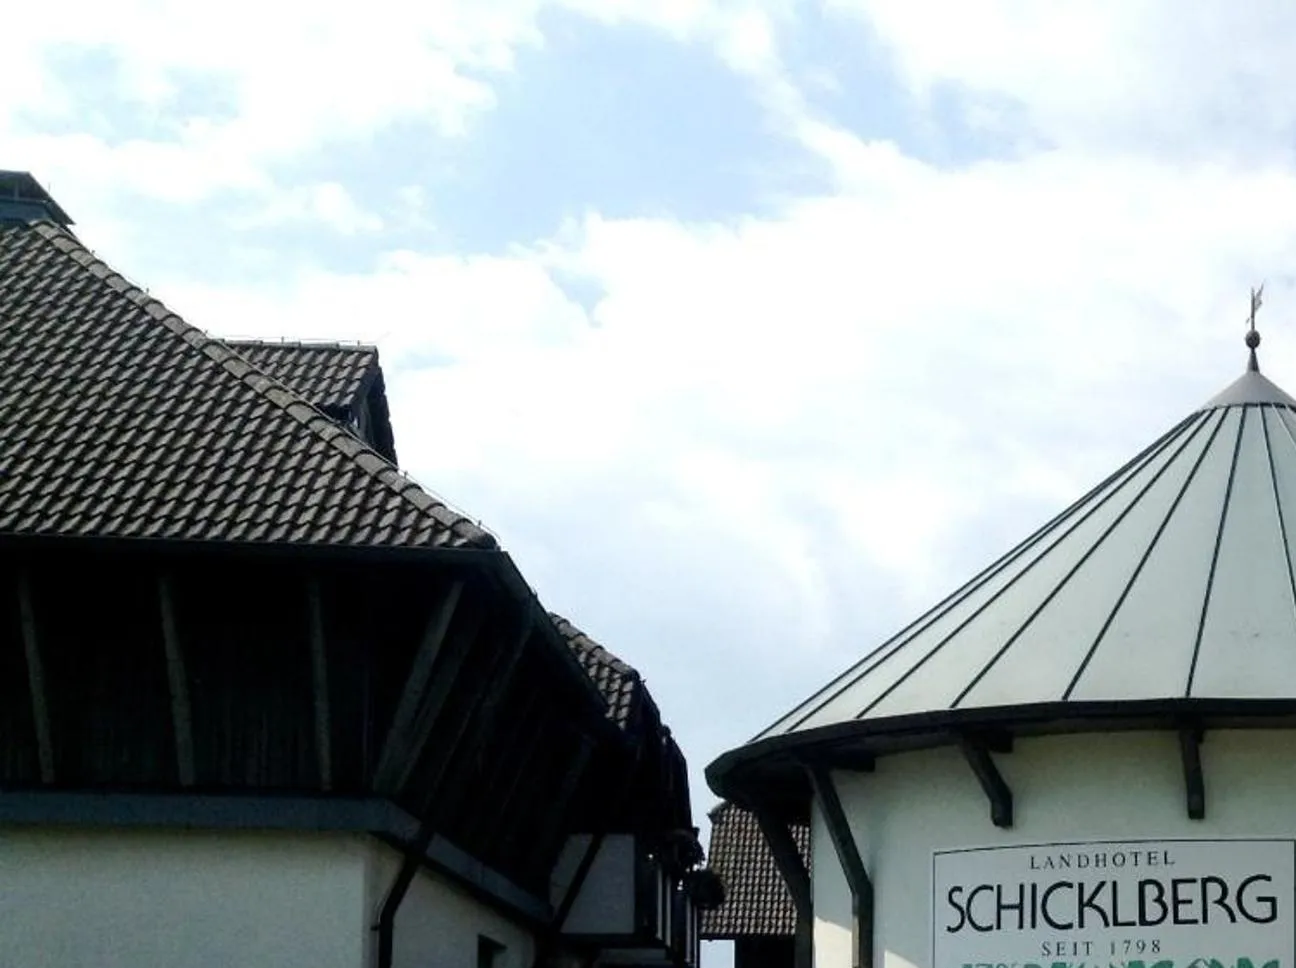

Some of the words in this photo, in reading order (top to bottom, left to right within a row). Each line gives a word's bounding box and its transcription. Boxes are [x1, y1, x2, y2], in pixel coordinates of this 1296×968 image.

[1030, 850, 1175, 870] LANDHOTEL
[946, 875, 1278, 933] SCHICKLBERG
[1041, 941, 1094, 956] SEIT
[1109, 939, 1162, 956] 1798
